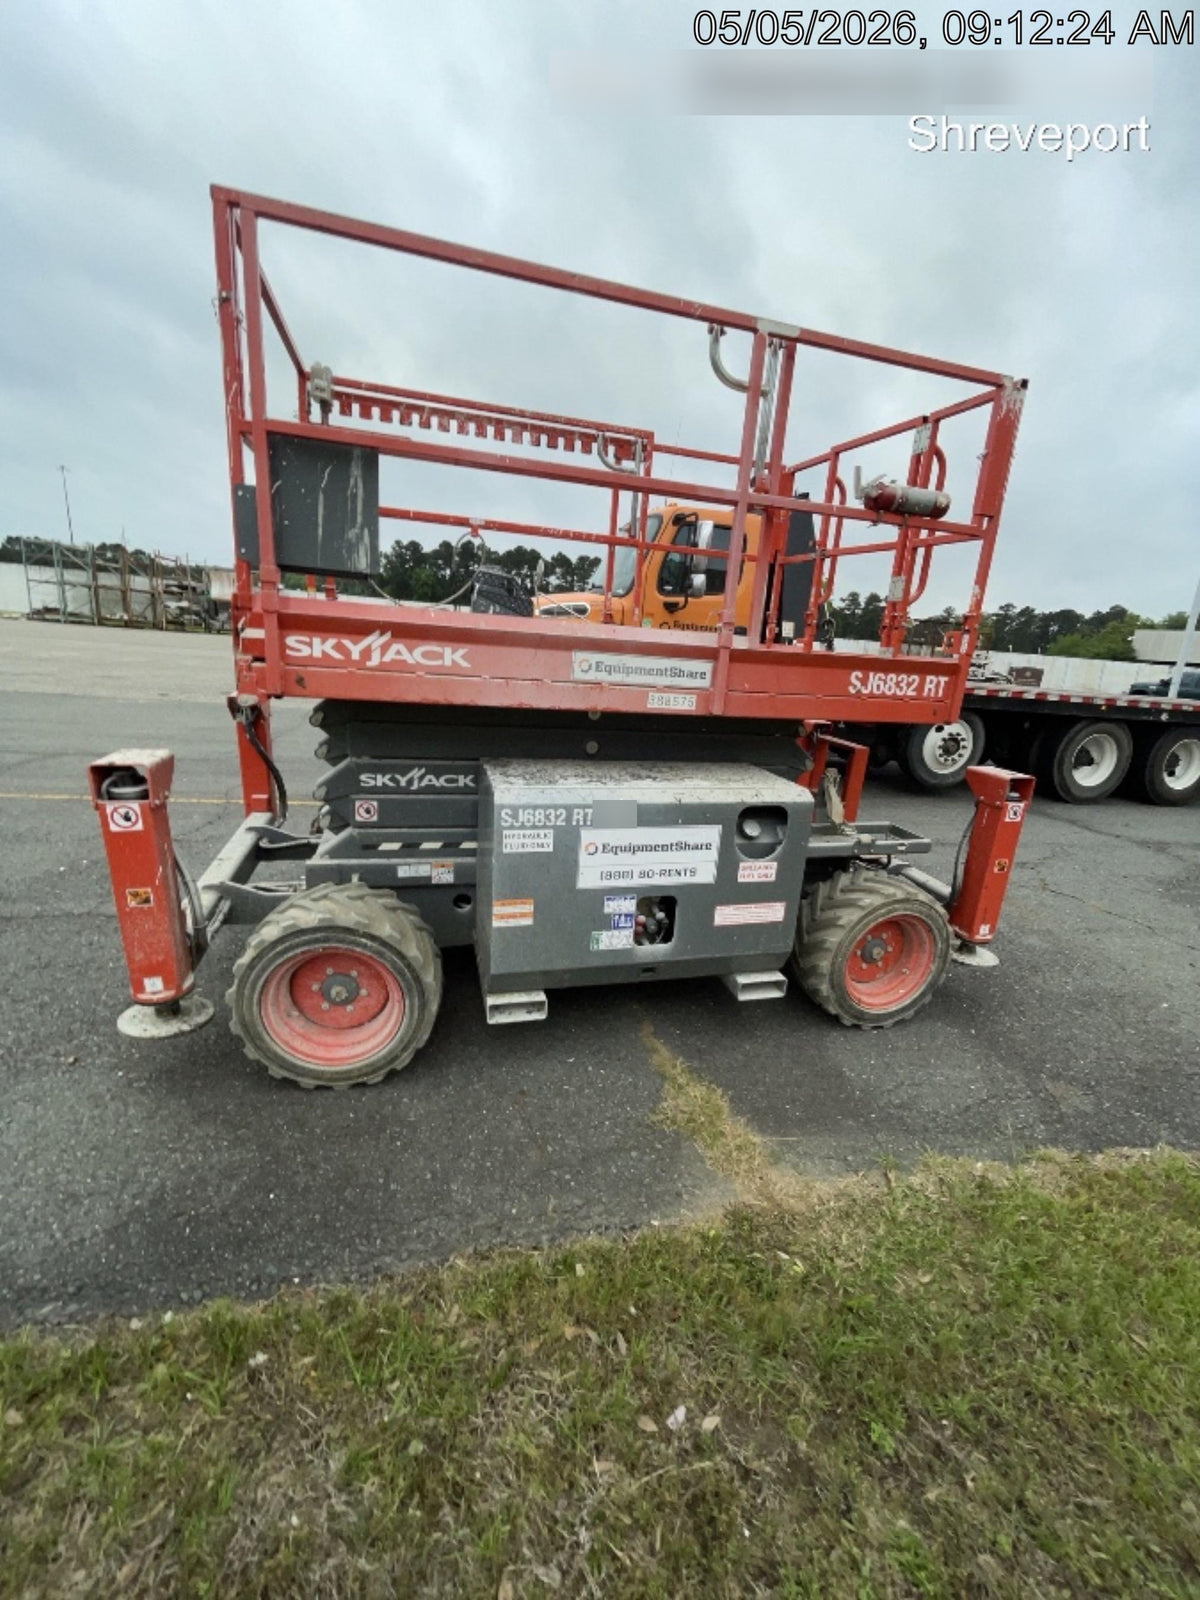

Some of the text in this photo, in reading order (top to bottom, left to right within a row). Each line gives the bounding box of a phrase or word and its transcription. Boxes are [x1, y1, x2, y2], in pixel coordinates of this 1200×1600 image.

[285, 629, 472, 668] SKYJACK
[594, 660, 707, 680] EquipmentShare
[848, 670, 950, 698] SJ6832 RT
[359, 767, 476, 790] SKYJACK
[500, 808, 594, 827] SJ6832 RT
[600, 841, 713, 856] EquipmentShare
